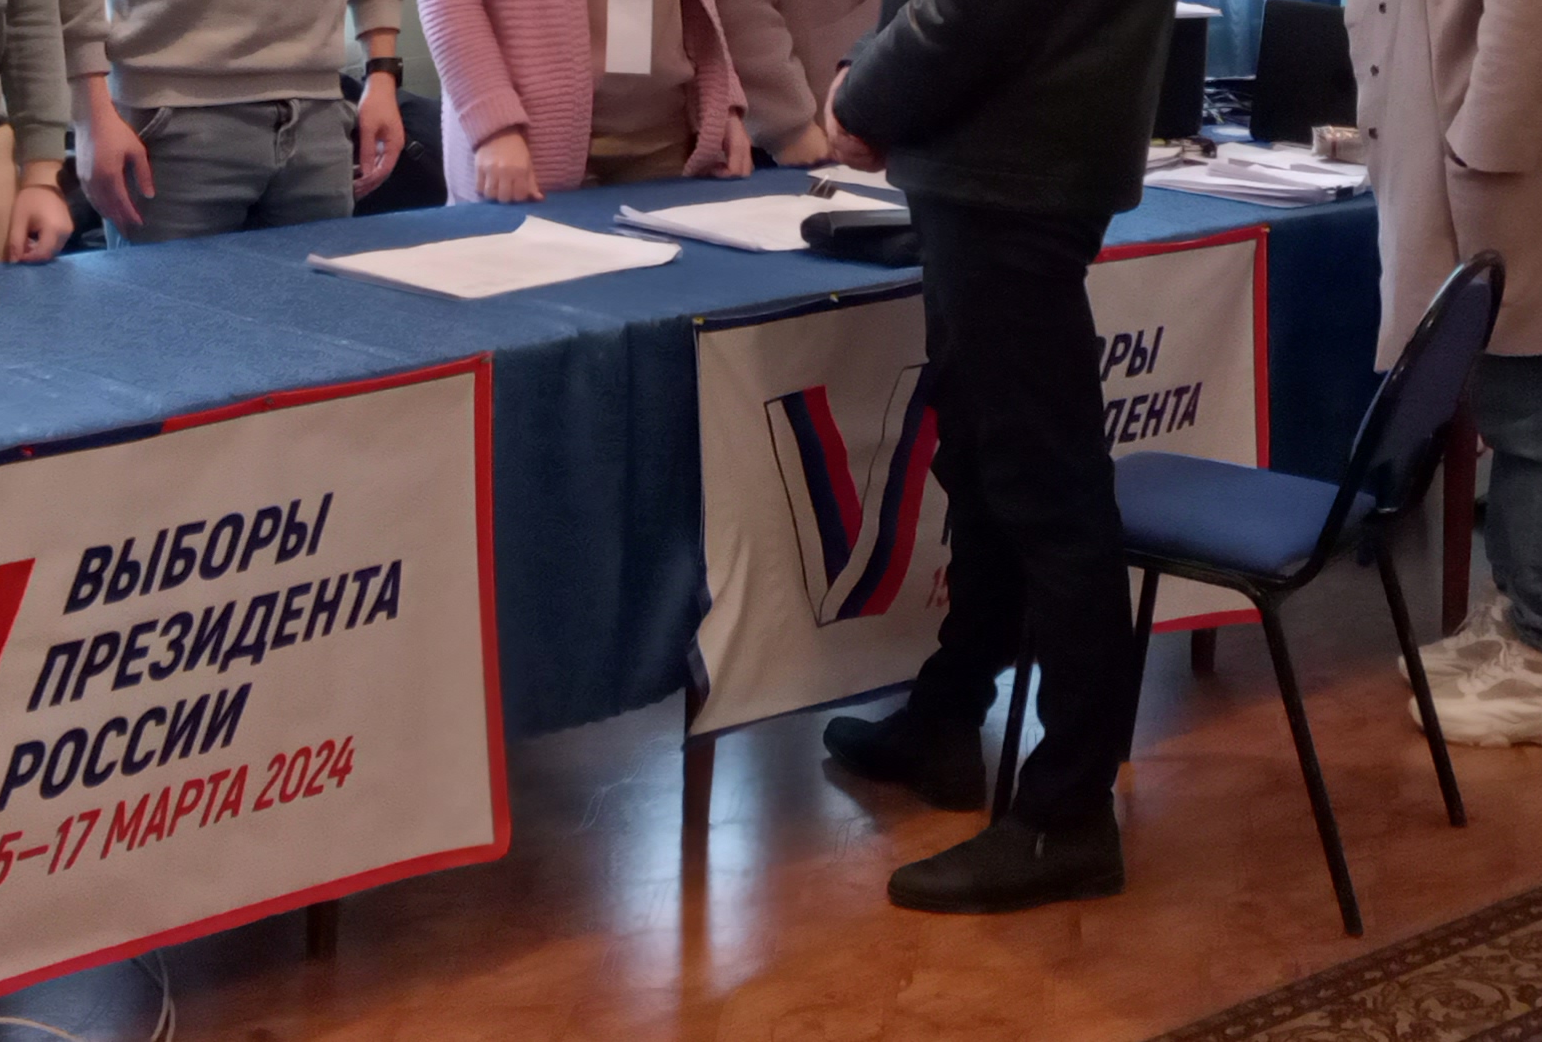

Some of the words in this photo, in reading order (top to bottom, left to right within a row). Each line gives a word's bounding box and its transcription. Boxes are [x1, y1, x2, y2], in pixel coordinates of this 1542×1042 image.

[63, 492, 334, 615] ВЫБОРЫ
[27, 559, 404, 713] ПРЕЗИДЕНТА
[101, 764, 245, 867] МАРТА
[253, 734, 356, 813] 2024
